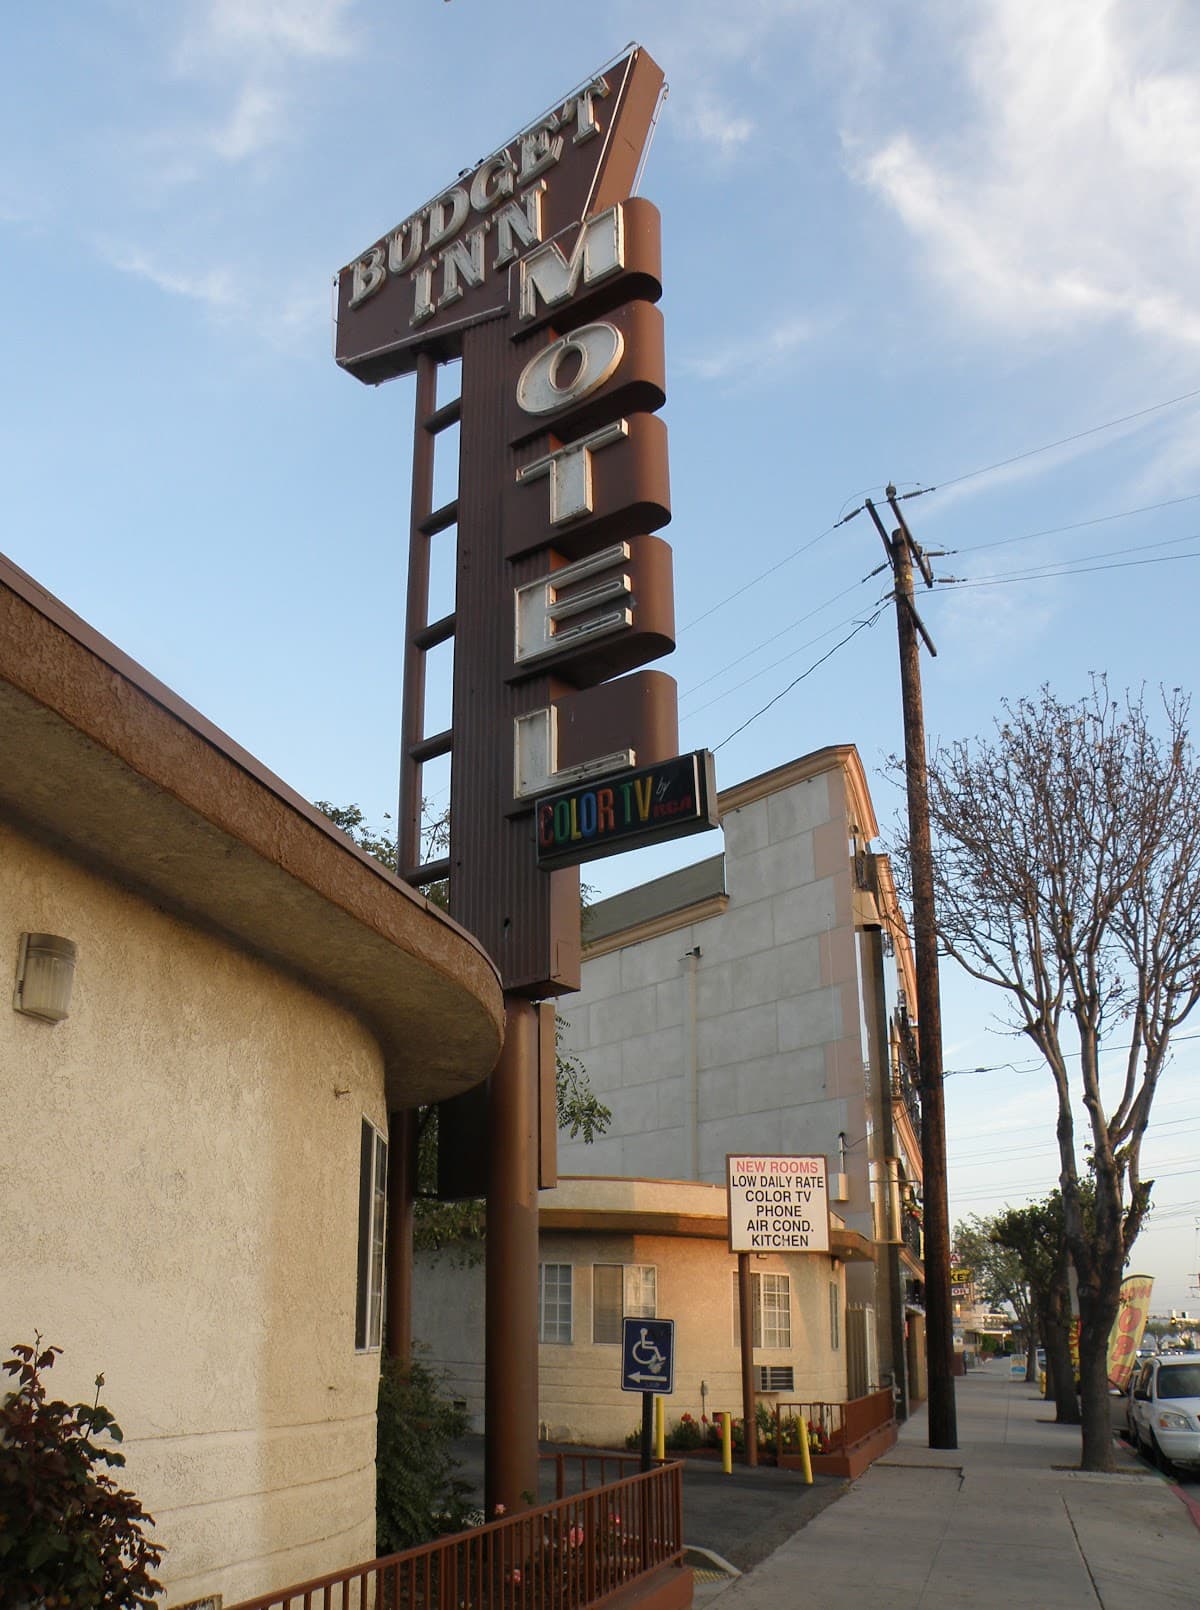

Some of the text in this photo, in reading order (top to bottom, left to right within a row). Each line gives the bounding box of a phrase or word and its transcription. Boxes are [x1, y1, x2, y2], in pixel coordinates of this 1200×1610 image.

[348, 74, 610, 310] BUDGET
[410, 179, 547, 328] INN
[513, 201, 637, 803] MOTEL
[656, 776, 671, 801] by
[539, 775, 654, 848] COLOR TV
[736, 1161, 819, 1174] NEW ROOMS
[732, 1175, 825, 1189] LOW DAILY RATE
[745, 1190, 811, 1203] COLOR TV
[756, 1205, 802, 1217] PHONE
[746, 1219, 815, 1232] AIR COND.
[751, 1234, 809, 1247] KITCHEN
